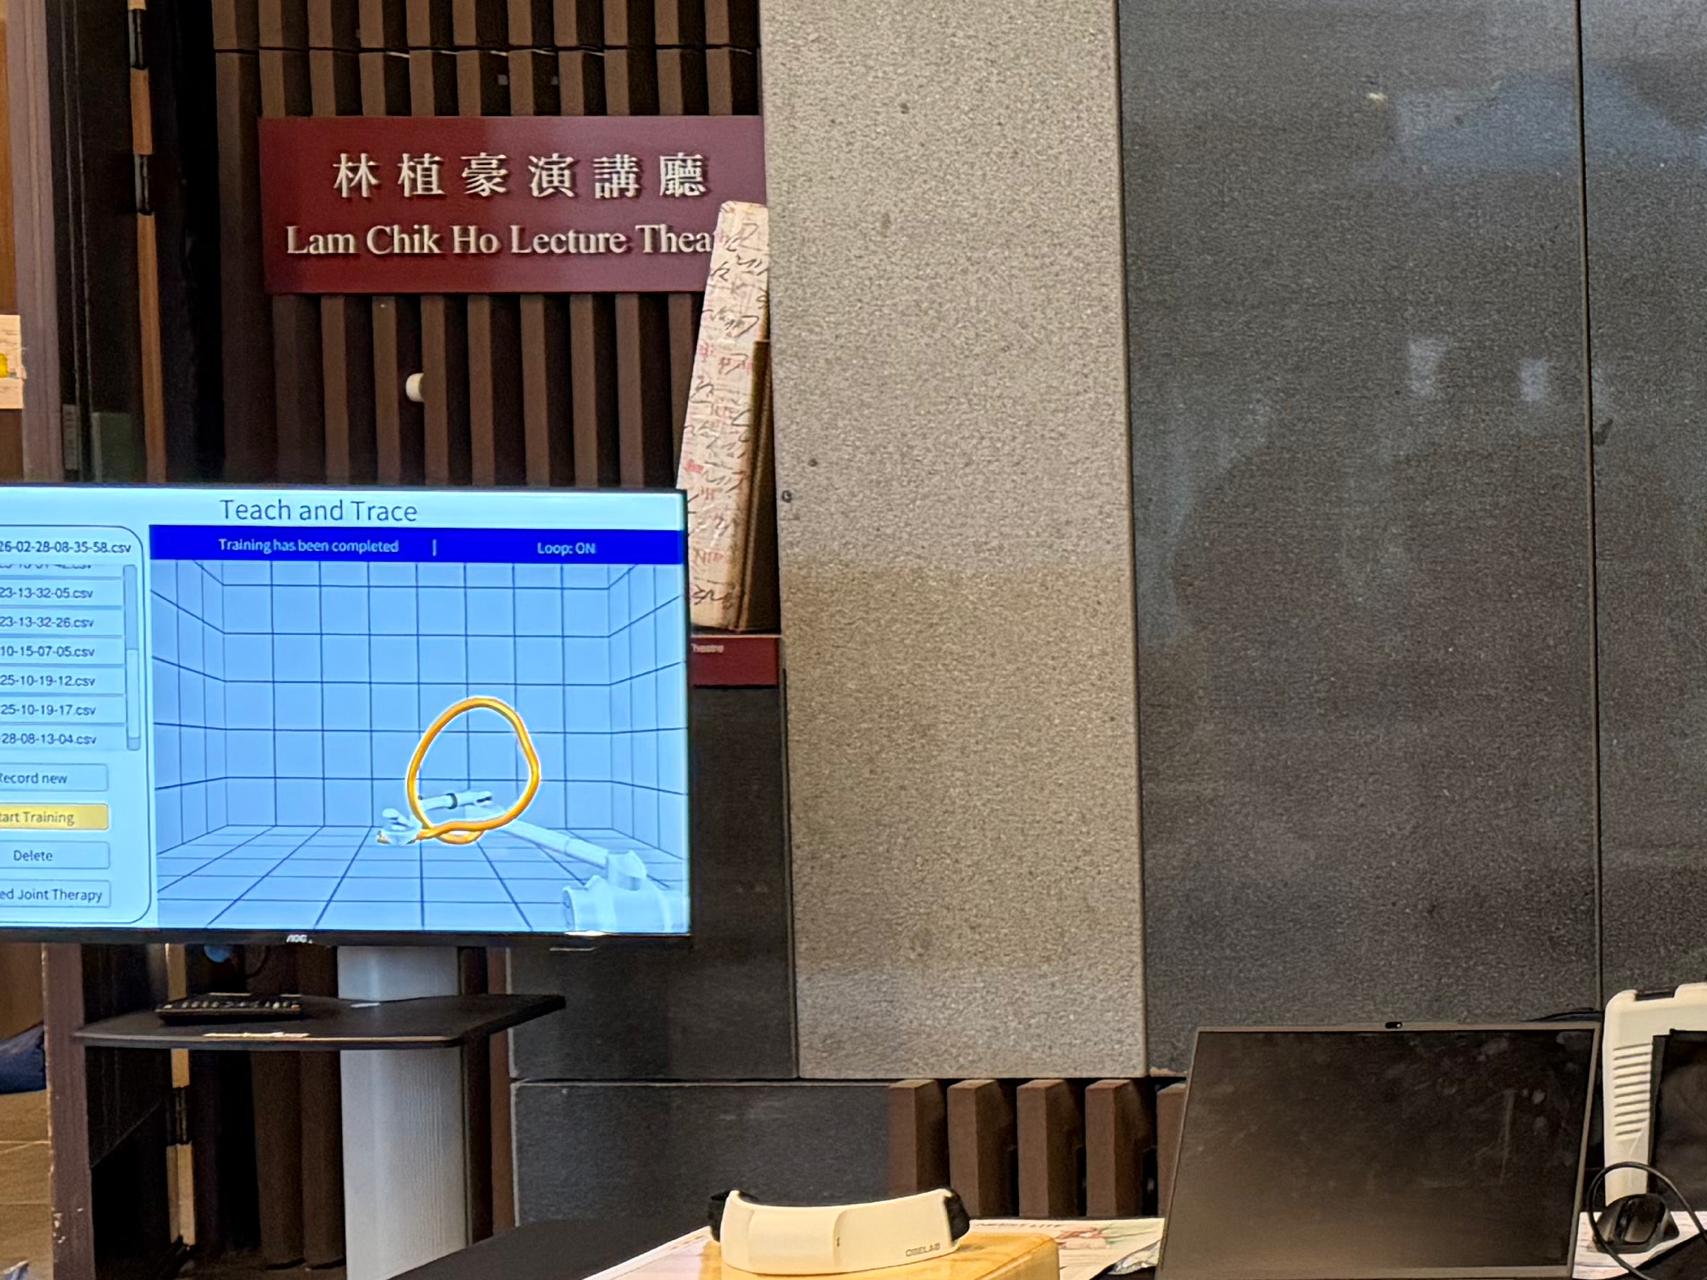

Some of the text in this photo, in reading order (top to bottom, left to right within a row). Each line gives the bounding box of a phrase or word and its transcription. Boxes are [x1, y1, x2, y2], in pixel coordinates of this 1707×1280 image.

[333, 153, 709, 199] 林植豪演講廳
[286, 224, 716, 255] Lam Chik Ho Lecture Thea
[220, 499, 418, 523] Teach and Trace
[218, 538, 400, 556] Training has been completed
[537, 541, 595, 556] Loop: ON
[42, 774, 67, 784] new
[23, 811, 75, 827] Training
[13, 849, 53, 862] Delete
[17, 889, 49, 901] Joint
[51, 888, 103, 904] Therapy
